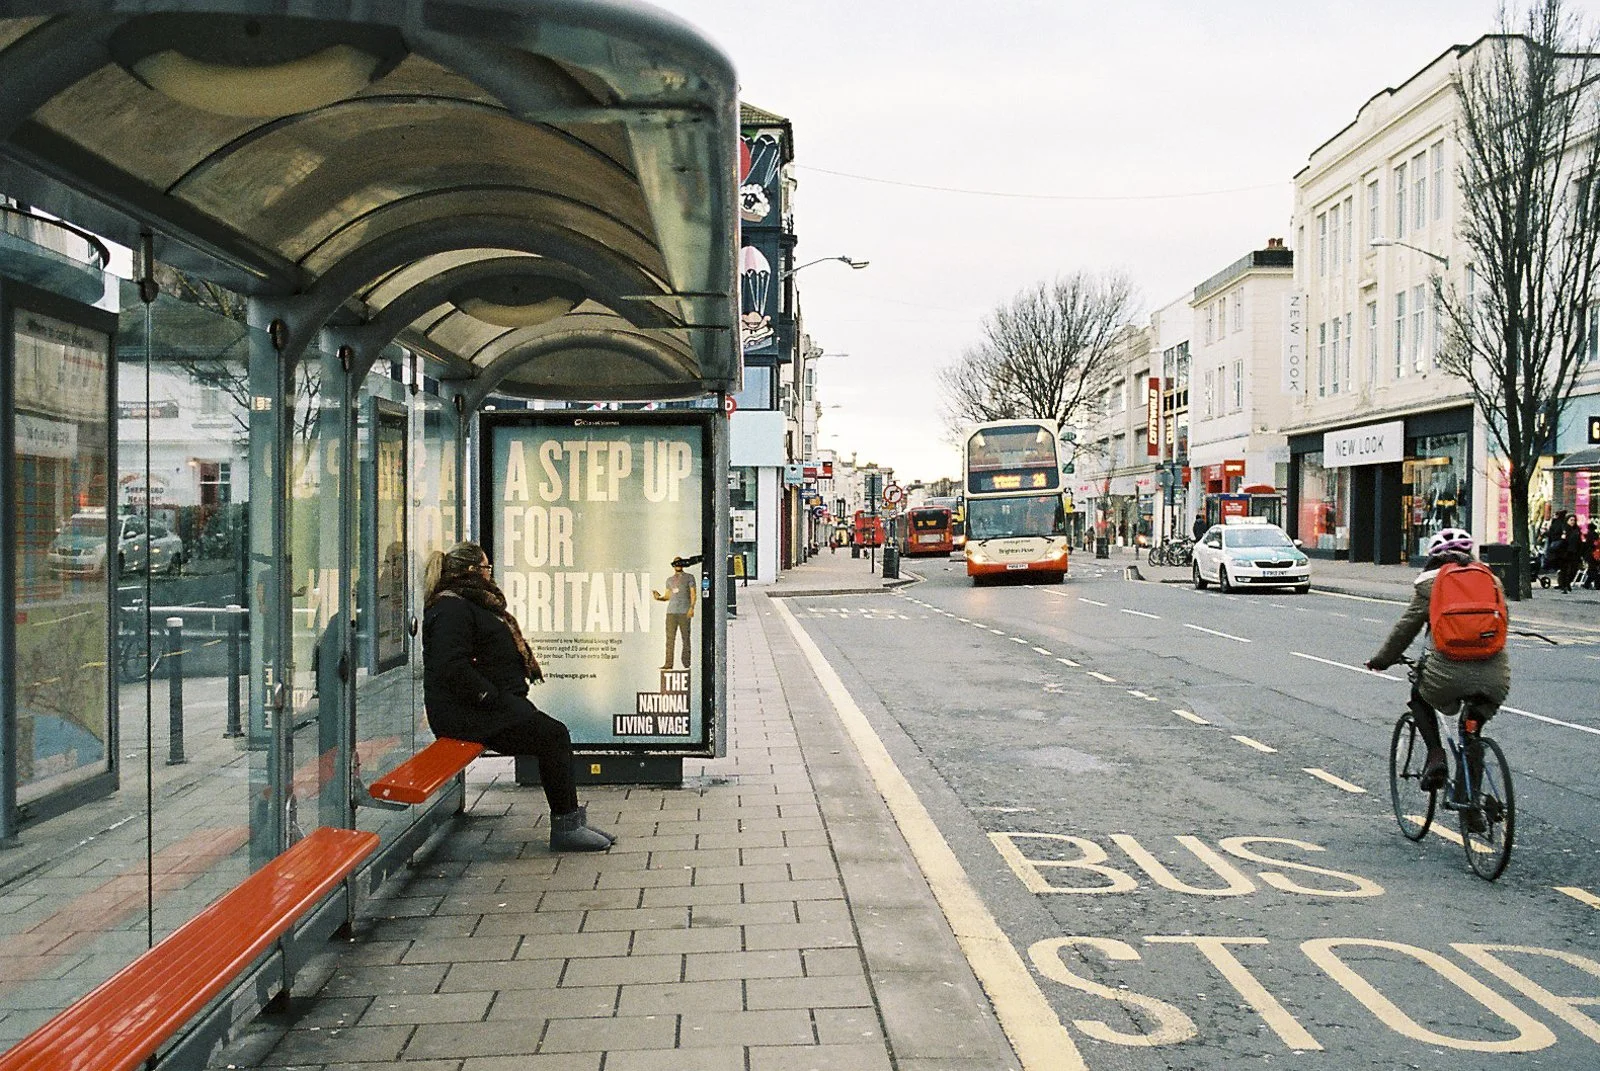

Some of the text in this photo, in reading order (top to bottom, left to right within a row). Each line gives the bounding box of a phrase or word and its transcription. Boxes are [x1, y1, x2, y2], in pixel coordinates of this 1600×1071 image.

[1290, 296, 1300, 391] NEW LOOK
[1148, 388, 1158, 445] COTSWOLD
[1335, 434, 1384, 457] NEW LOOK
[504, 440, 692, 503] A STEP UP
[504, 506, 574, 568] FOR
[504, 572, 650, 632] BRITAIN
[639, 694, 689, 713] NATIONAL
[664, 672, 689, 691] THE
[616, 716, 690, 734] LIVING WAGE
[986, 831, 1386, 897] BUS
[1027, 934, 1600, 1053] STOP
